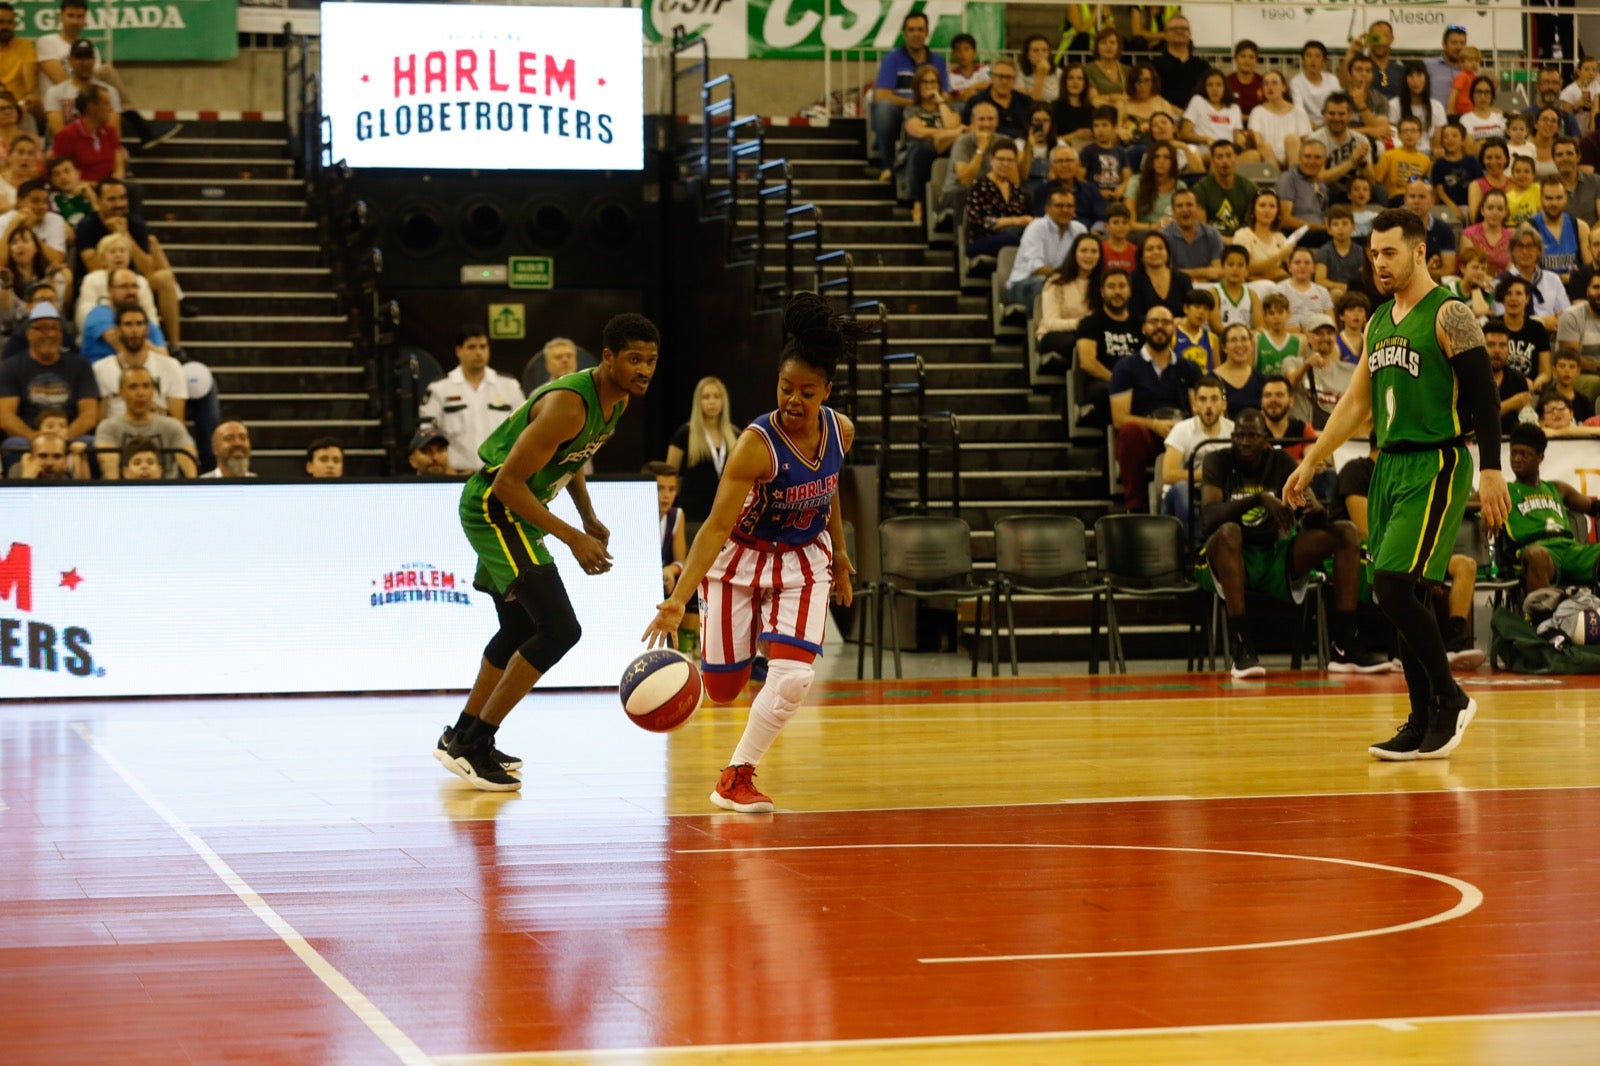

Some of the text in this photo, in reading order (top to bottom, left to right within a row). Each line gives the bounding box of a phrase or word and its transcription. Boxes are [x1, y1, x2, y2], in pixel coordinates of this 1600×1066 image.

[34, 6, 186, 31] GANADA
[1261, 8, 1295, 20] 1990
[1389, 9, 1445, 25] Mesón
[394, 49, 576, 101] HARLEM
[356, 101, 614, 144] GLOBETROTTERS
[384, 571, 454, 590] HARLEM
